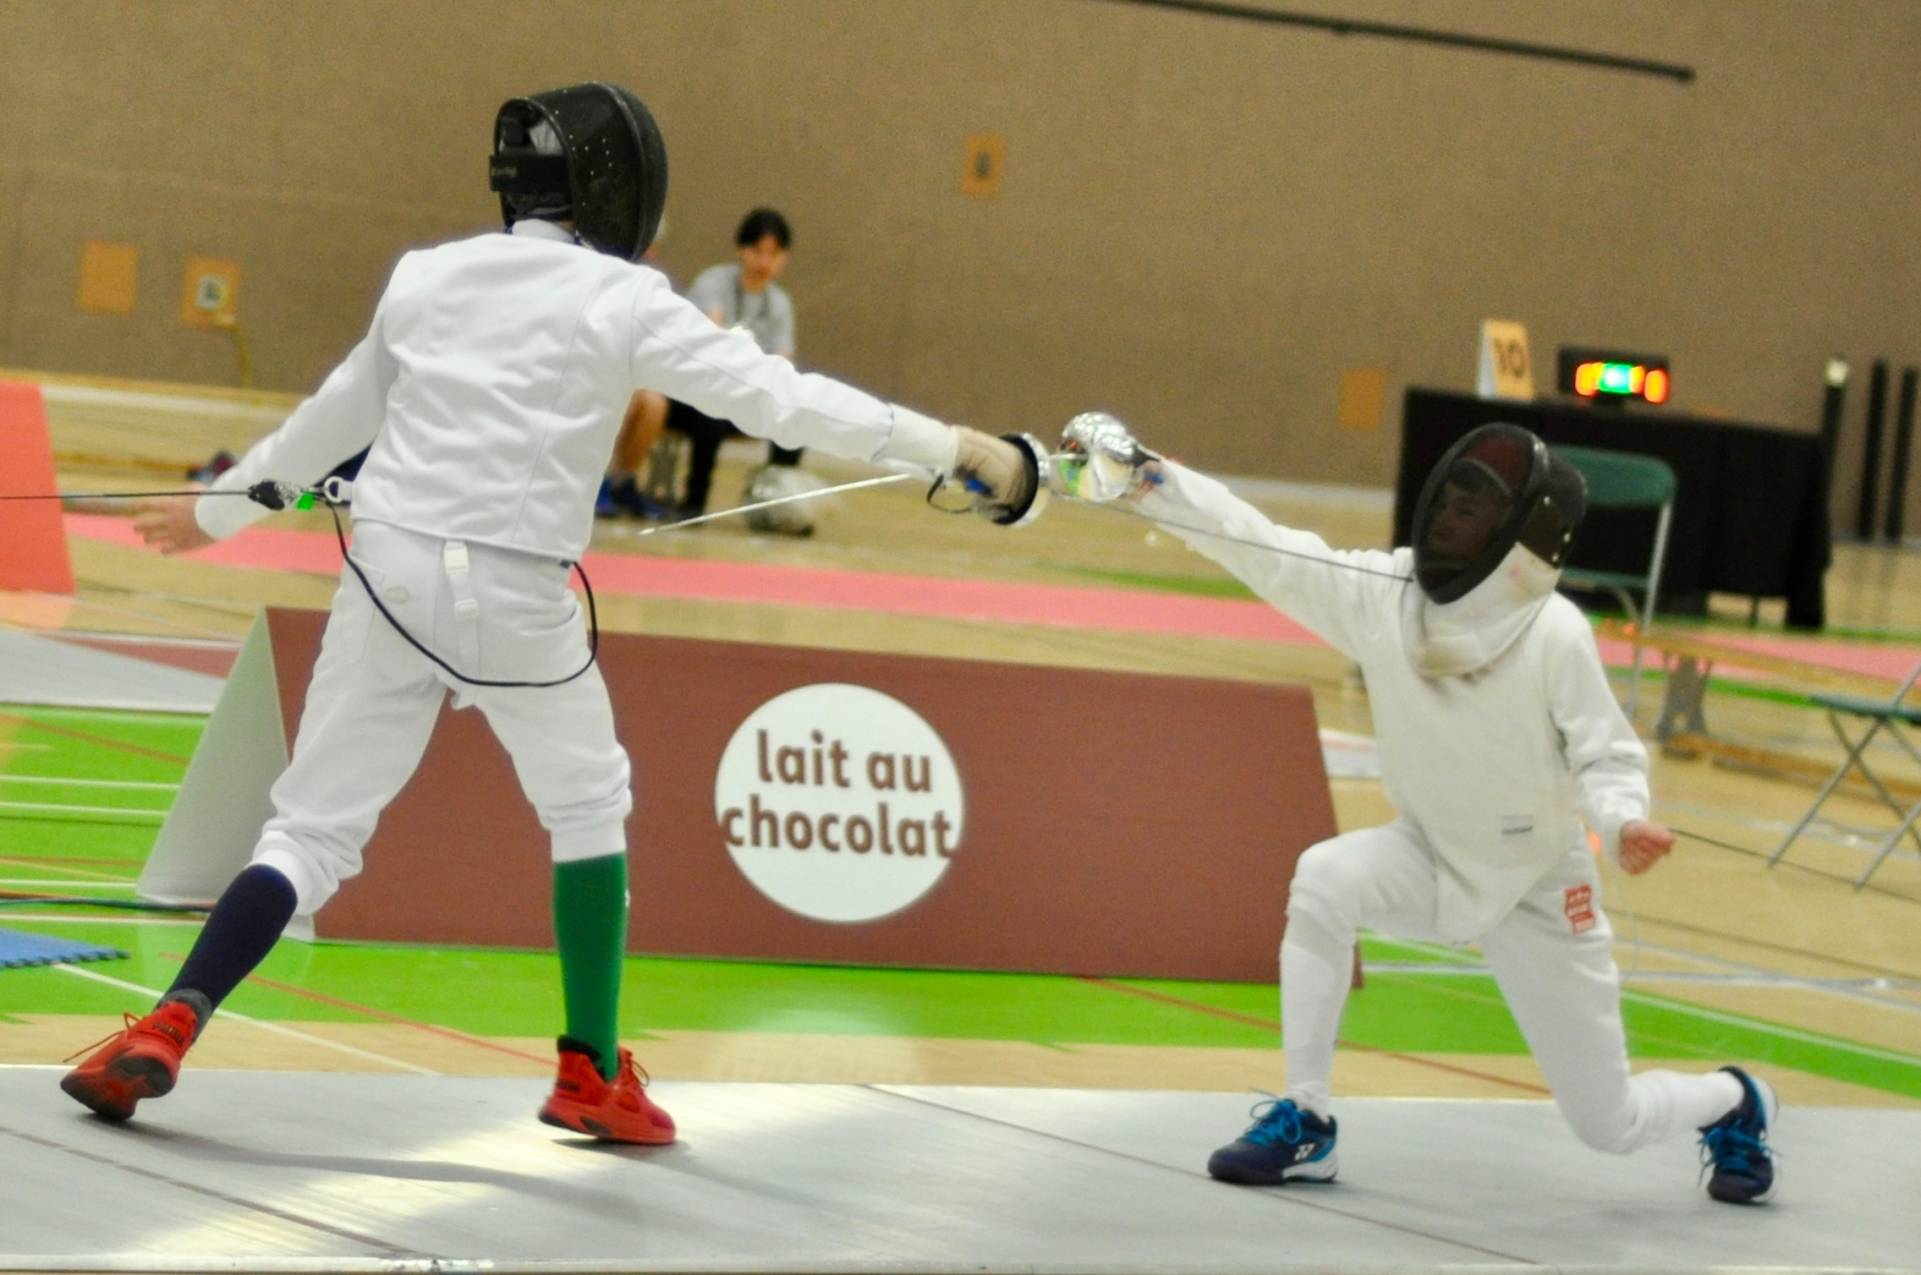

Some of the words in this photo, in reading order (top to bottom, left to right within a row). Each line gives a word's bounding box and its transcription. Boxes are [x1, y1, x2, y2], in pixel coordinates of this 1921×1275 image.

[757, 728, 851, 788] lait
[866, 751, 931, 792] au
[721, 793, 952, 858] chocolat
